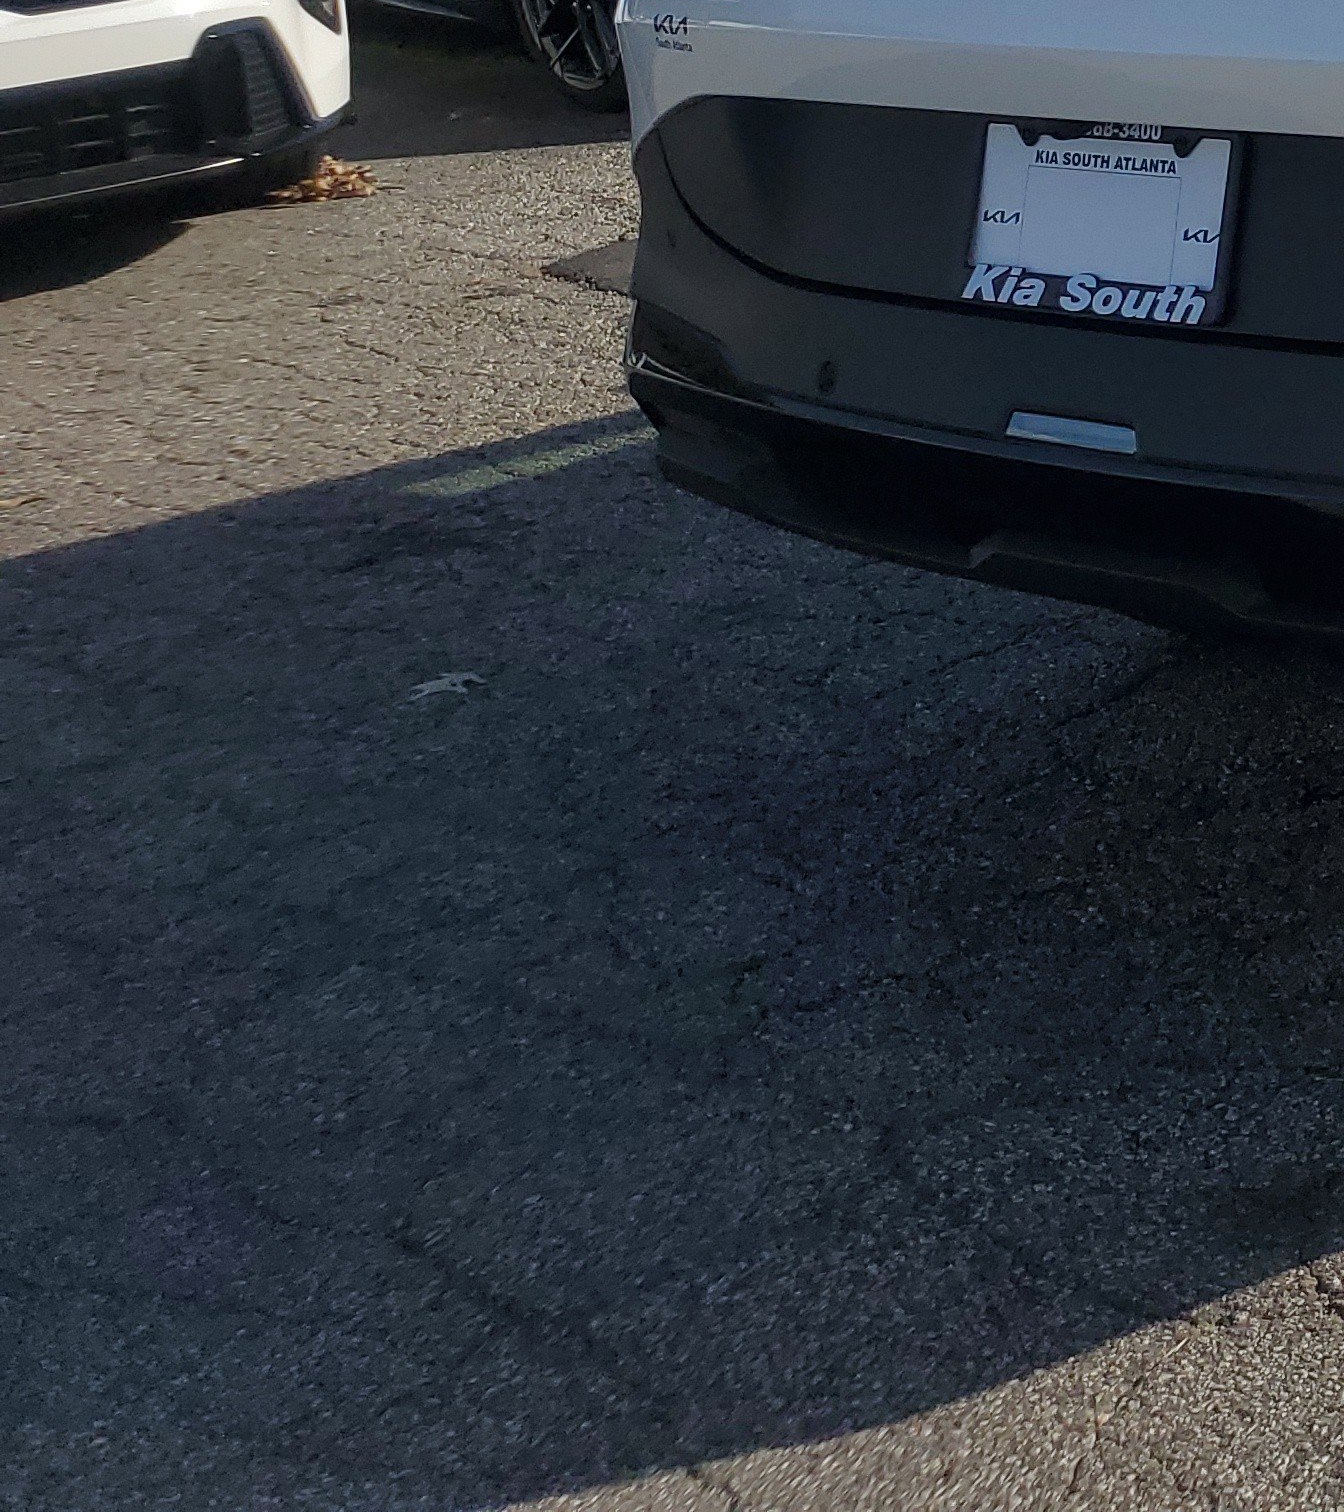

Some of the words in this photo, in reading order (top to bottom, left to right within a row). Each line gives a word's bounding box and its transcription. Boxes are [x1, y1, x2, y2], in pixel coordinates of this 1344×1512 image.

[653, 14, 688, 35] KIA
[1035, 149, 1058, 165] KIA
[1062, 152, 1110, 169] SOUTH
[1114, 156, 1176, 174] ATLANTA
[982, 209, 1020, 224] KIA
[961, 263, 1046, 307] Kia
[1059, 273, 1206, 325] South
